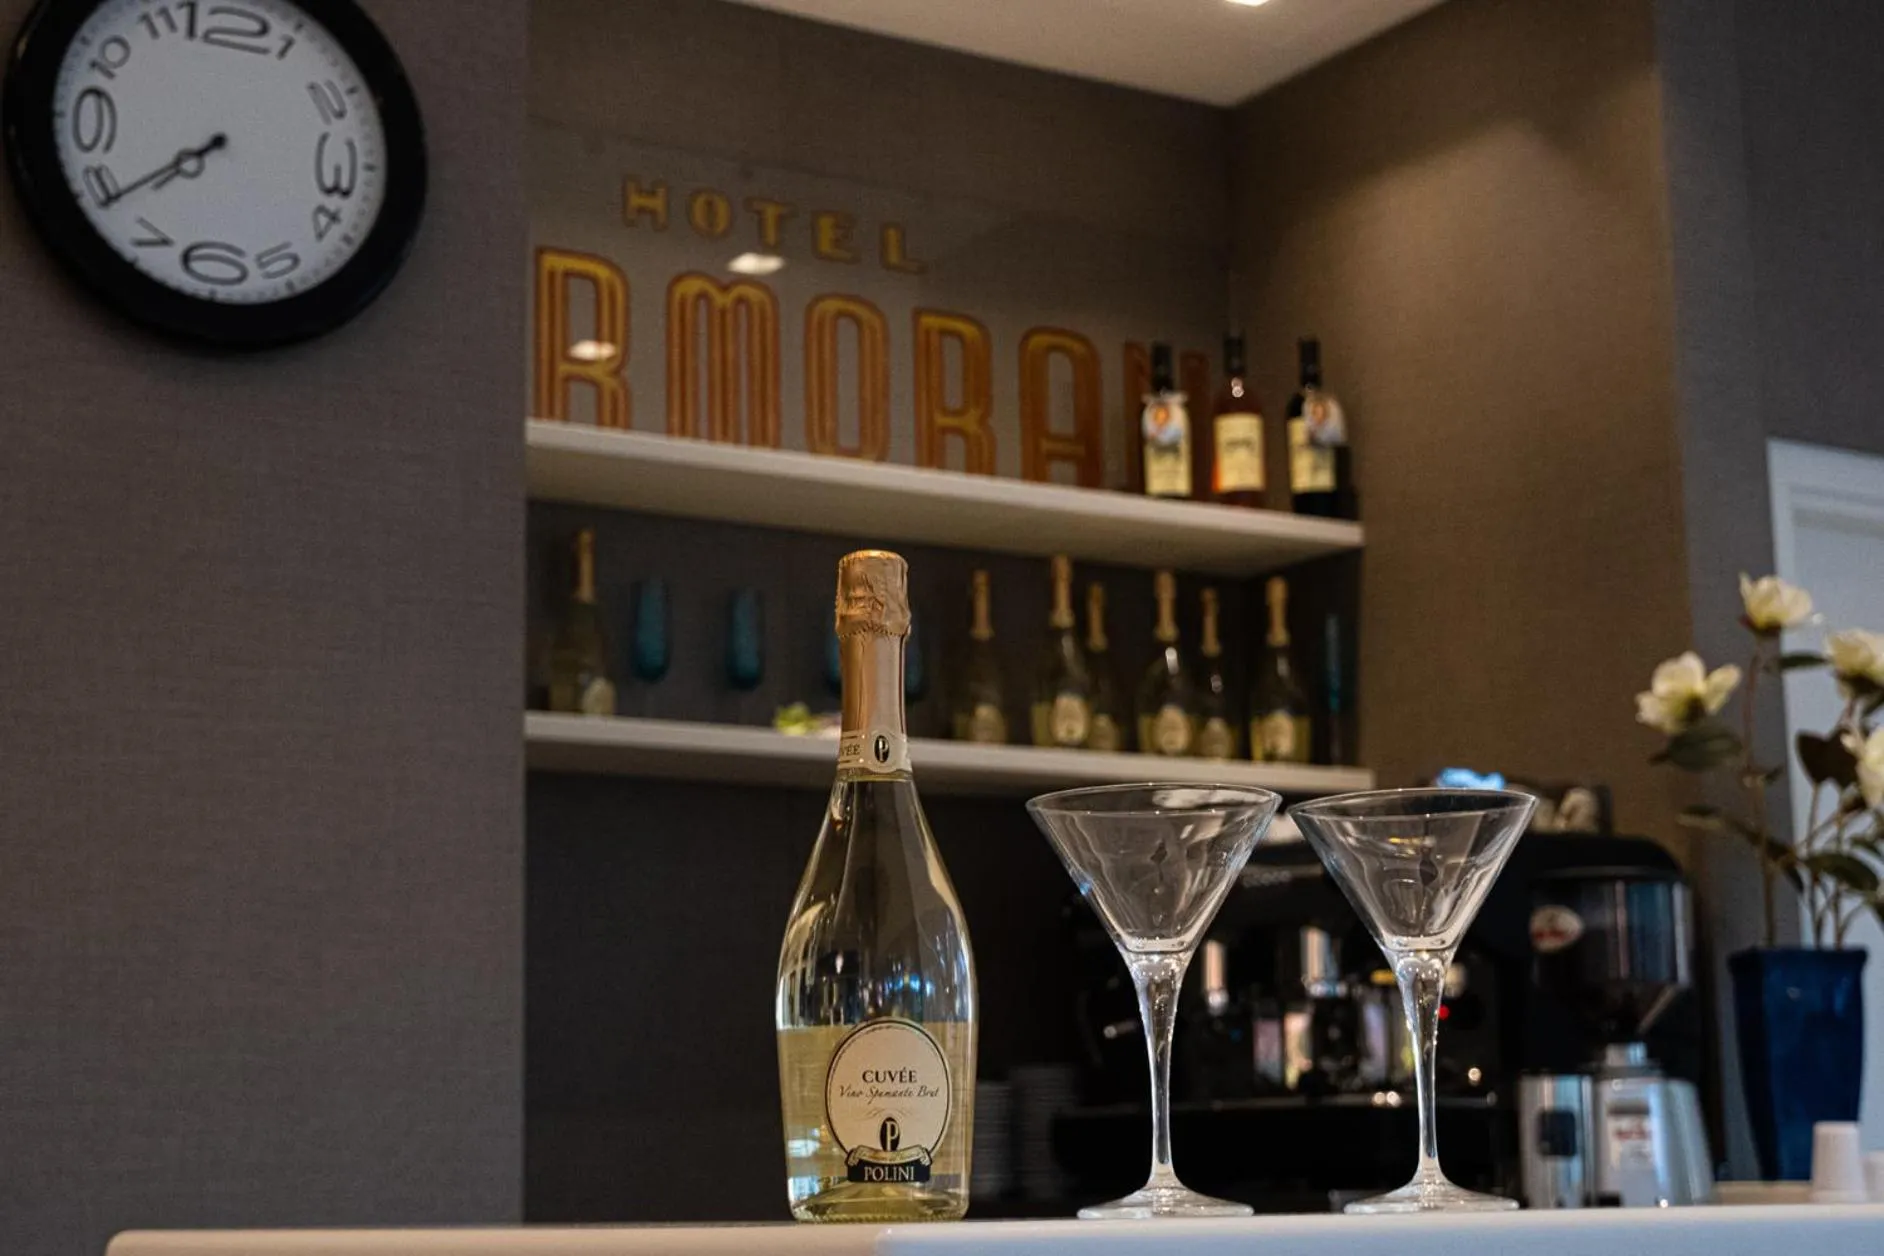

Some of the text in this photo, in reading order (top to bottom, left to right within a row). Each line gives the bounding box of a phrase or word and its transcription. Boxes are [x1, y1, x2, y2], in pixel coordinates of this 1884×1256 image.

[137, 6, 178, 40] 11
[175, 0, 272, 55] 12
[88, 35, 131, 81] 10
[275, 33, 296, 60] 1
[73, 85, 117, 153] 9
[306, 79, 347, 126] 2
[314, 131, 357, 199] 3
[130, 217, 175, 248] 7
[311, 204, 342, 243] 4
[623, 176, 927, 274] HOTEL
[180, 241, 250, 287] 6
[254, 242, 301, 280] 5
[839, 1084, 939, 1104] Vino Spumante Brut
[862, 1067, 917, 1083] CUVÉE
[863, 1165, 915, 1182] POLINI
